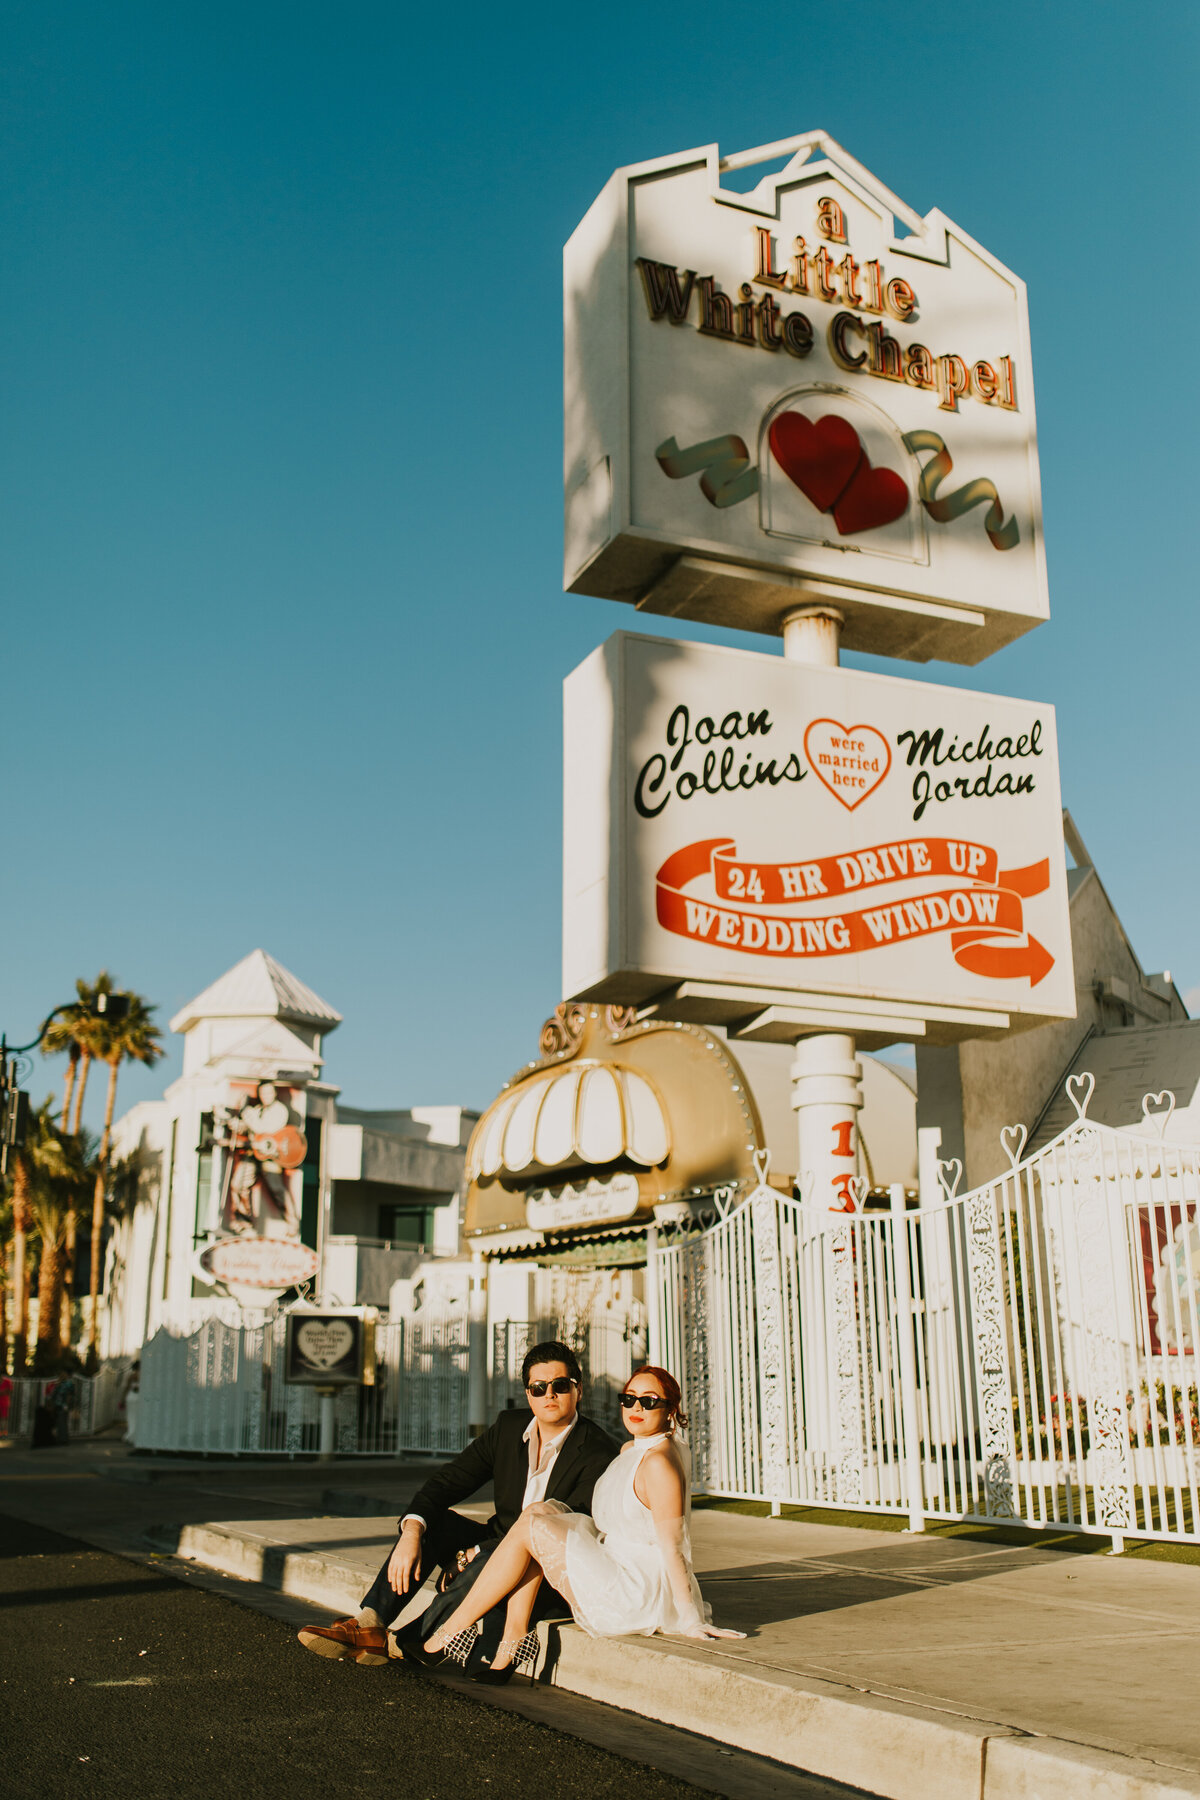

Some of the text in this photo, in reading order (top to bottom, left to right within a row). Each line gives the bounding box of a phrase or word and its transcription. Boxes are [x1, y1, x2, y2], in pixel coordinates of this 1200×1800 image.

[817, 197, 847, 243] a
[752, 226, 914, 320] Little
[635, 257, 1017, 412] White Chapel
[667, 704, 773, 772] Joan
[818, 753, 879, 773] married
[830, 736, 865, 753] were
[897, 719, 1043, 767] Michael
[633, 746, 808, 820] Collins
[832, 769, 866, 789] here
[912, 764, 1036, 821] Jordan
[728, 842, 987, 903] 24 HR DRIVE UP
[685, 892, 1001, 953] WEDDING WINDOW
